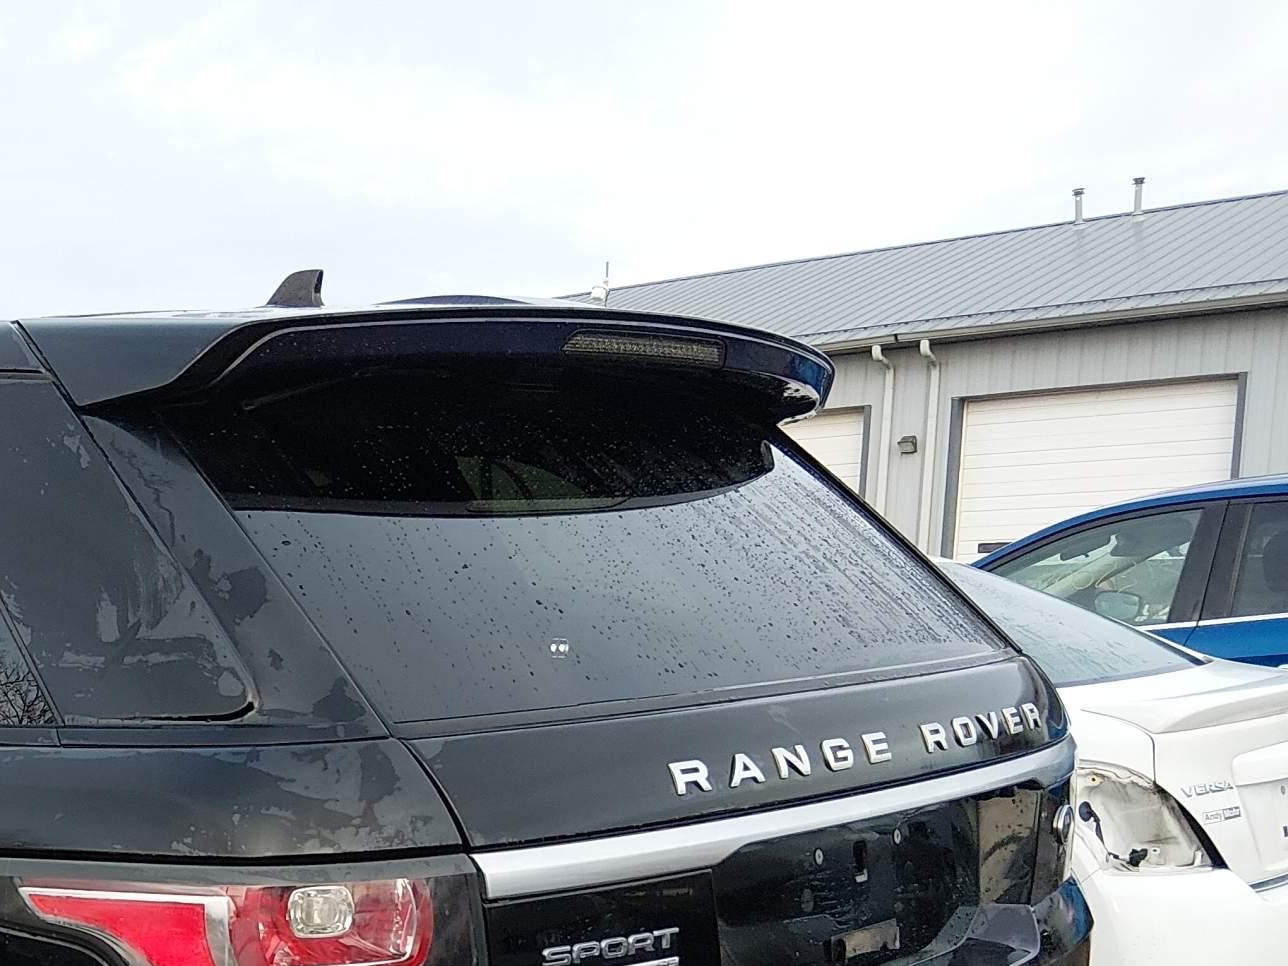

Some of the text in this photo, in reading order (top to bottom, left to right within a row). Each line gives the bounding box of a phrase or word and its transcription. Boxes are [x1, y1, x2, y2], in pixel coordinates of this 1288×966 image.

[667, 702, 1042, 797] RANGE ROVER
[1180, 780, 1235, 798] VERSA
